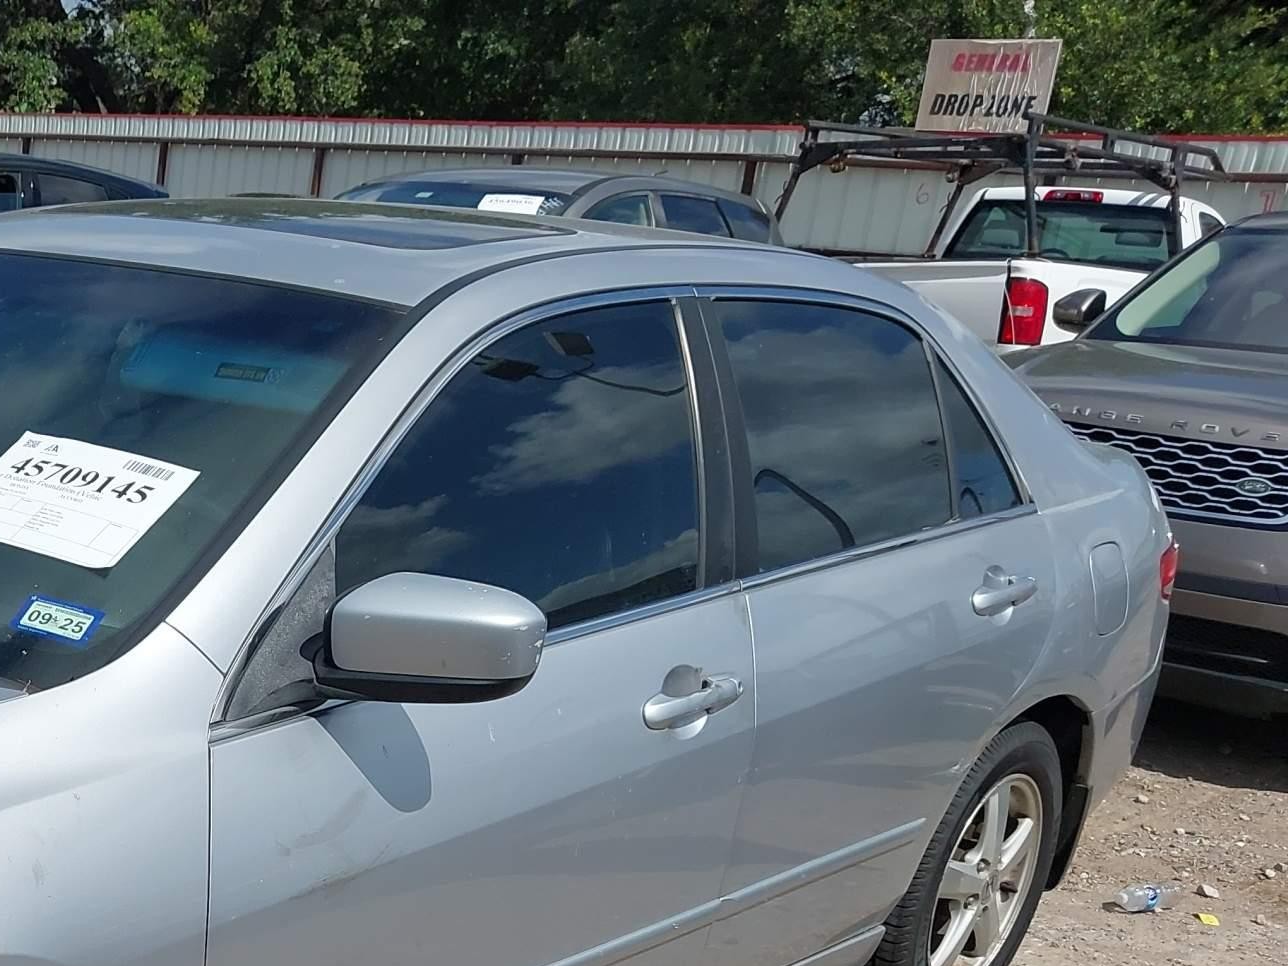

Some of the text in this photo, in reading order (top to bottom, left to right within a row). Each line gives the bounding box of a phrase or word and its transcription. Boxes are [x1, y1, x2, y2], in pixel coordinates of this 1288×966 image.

[952, 50, 1032, 73] GENERAL
[929, 93, 1037, 118] DROP ZONE
[915, 183, 929, 205] 6
[1049, 402, 1145, 424] ANGE
[10, 457, 155, 504] 45709145
[27, 609, 53, 625] 09
[58, 617, 86, 634] 25
